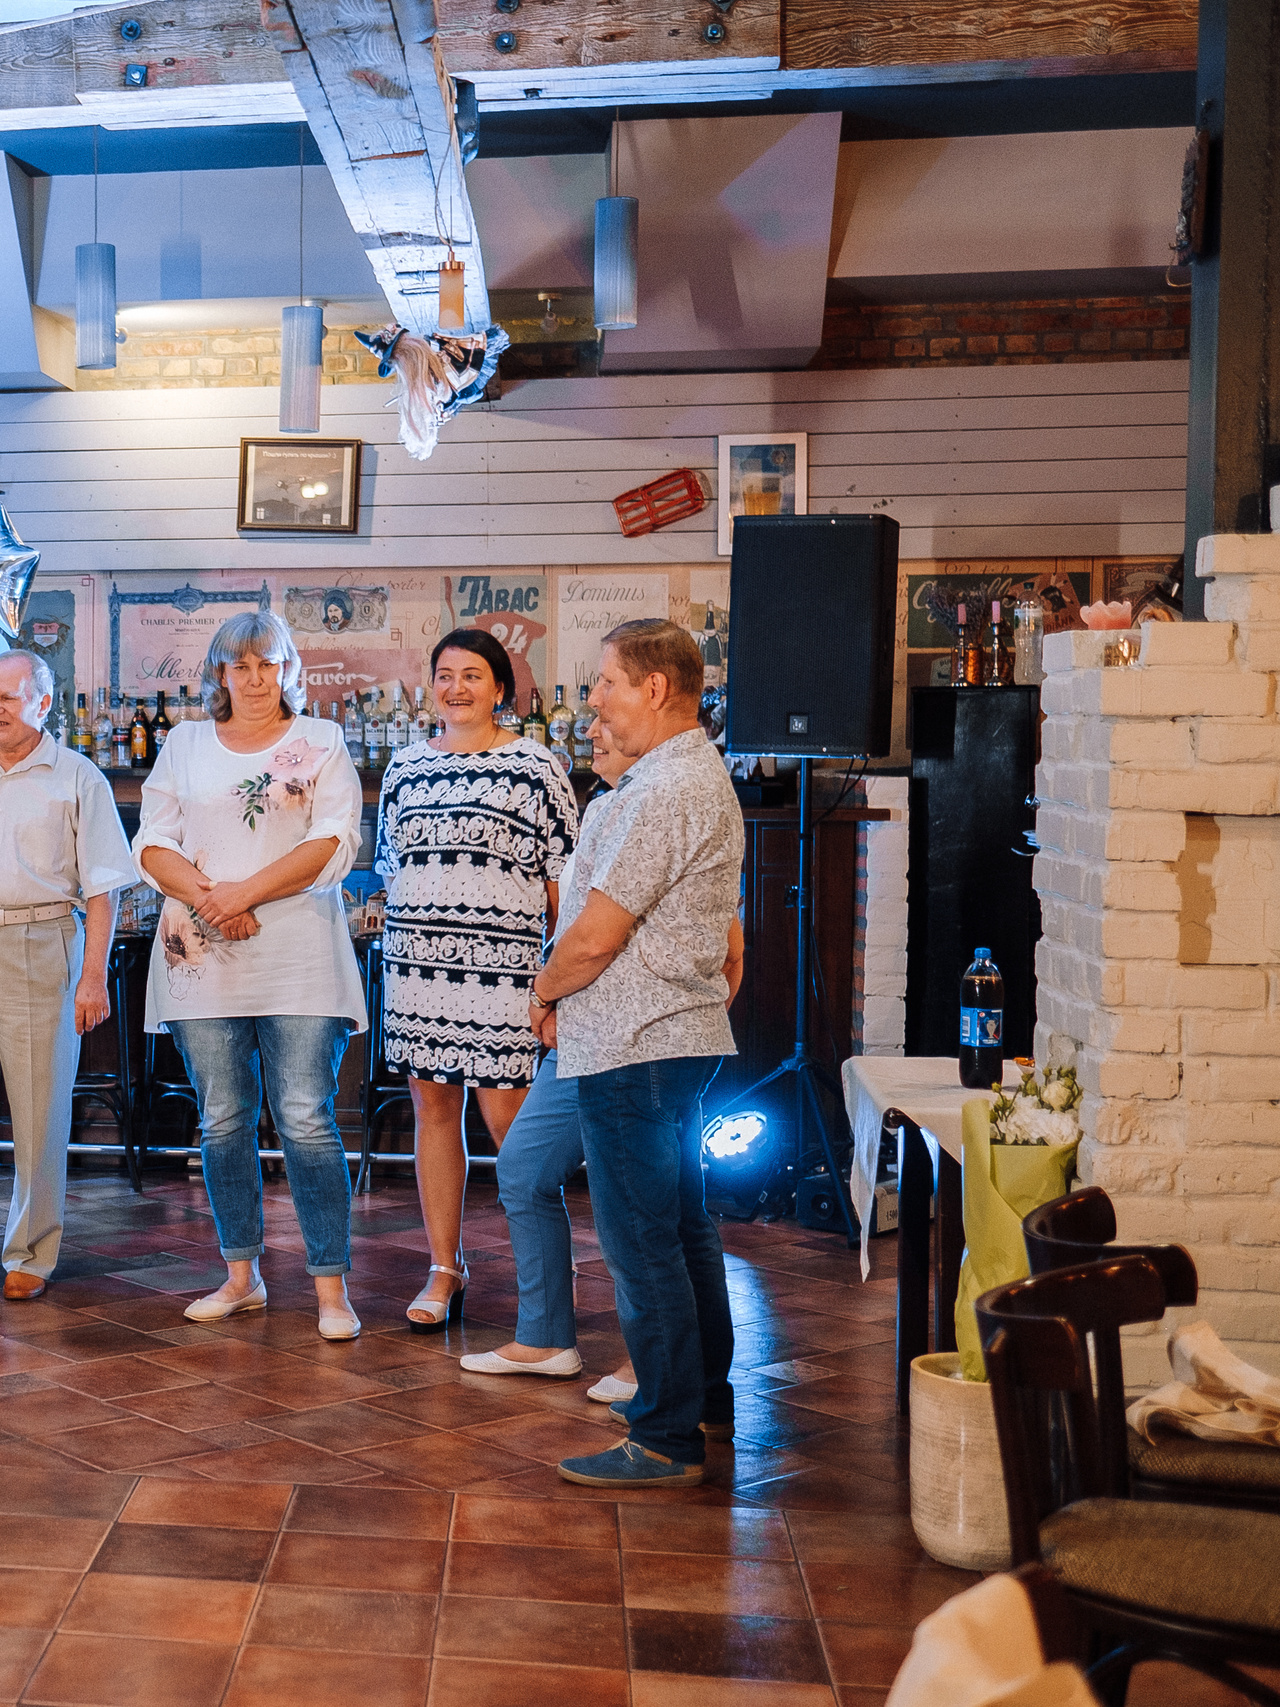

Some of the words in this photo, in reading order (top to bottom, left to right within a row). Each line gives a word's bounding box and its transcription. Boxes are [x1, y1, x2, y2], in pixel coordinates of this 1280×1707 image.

[458, 576, 539, 617] TABAC
[562, 580, 645, 603] Dominus
[140, 618, 175, 626] CHABLIS
[178, 618, 215, 626] PREMIER
[563, 611, 600, 633] Napa
[600, 611, 628, 629] Vall
[490, 623, 528, 654] 24
